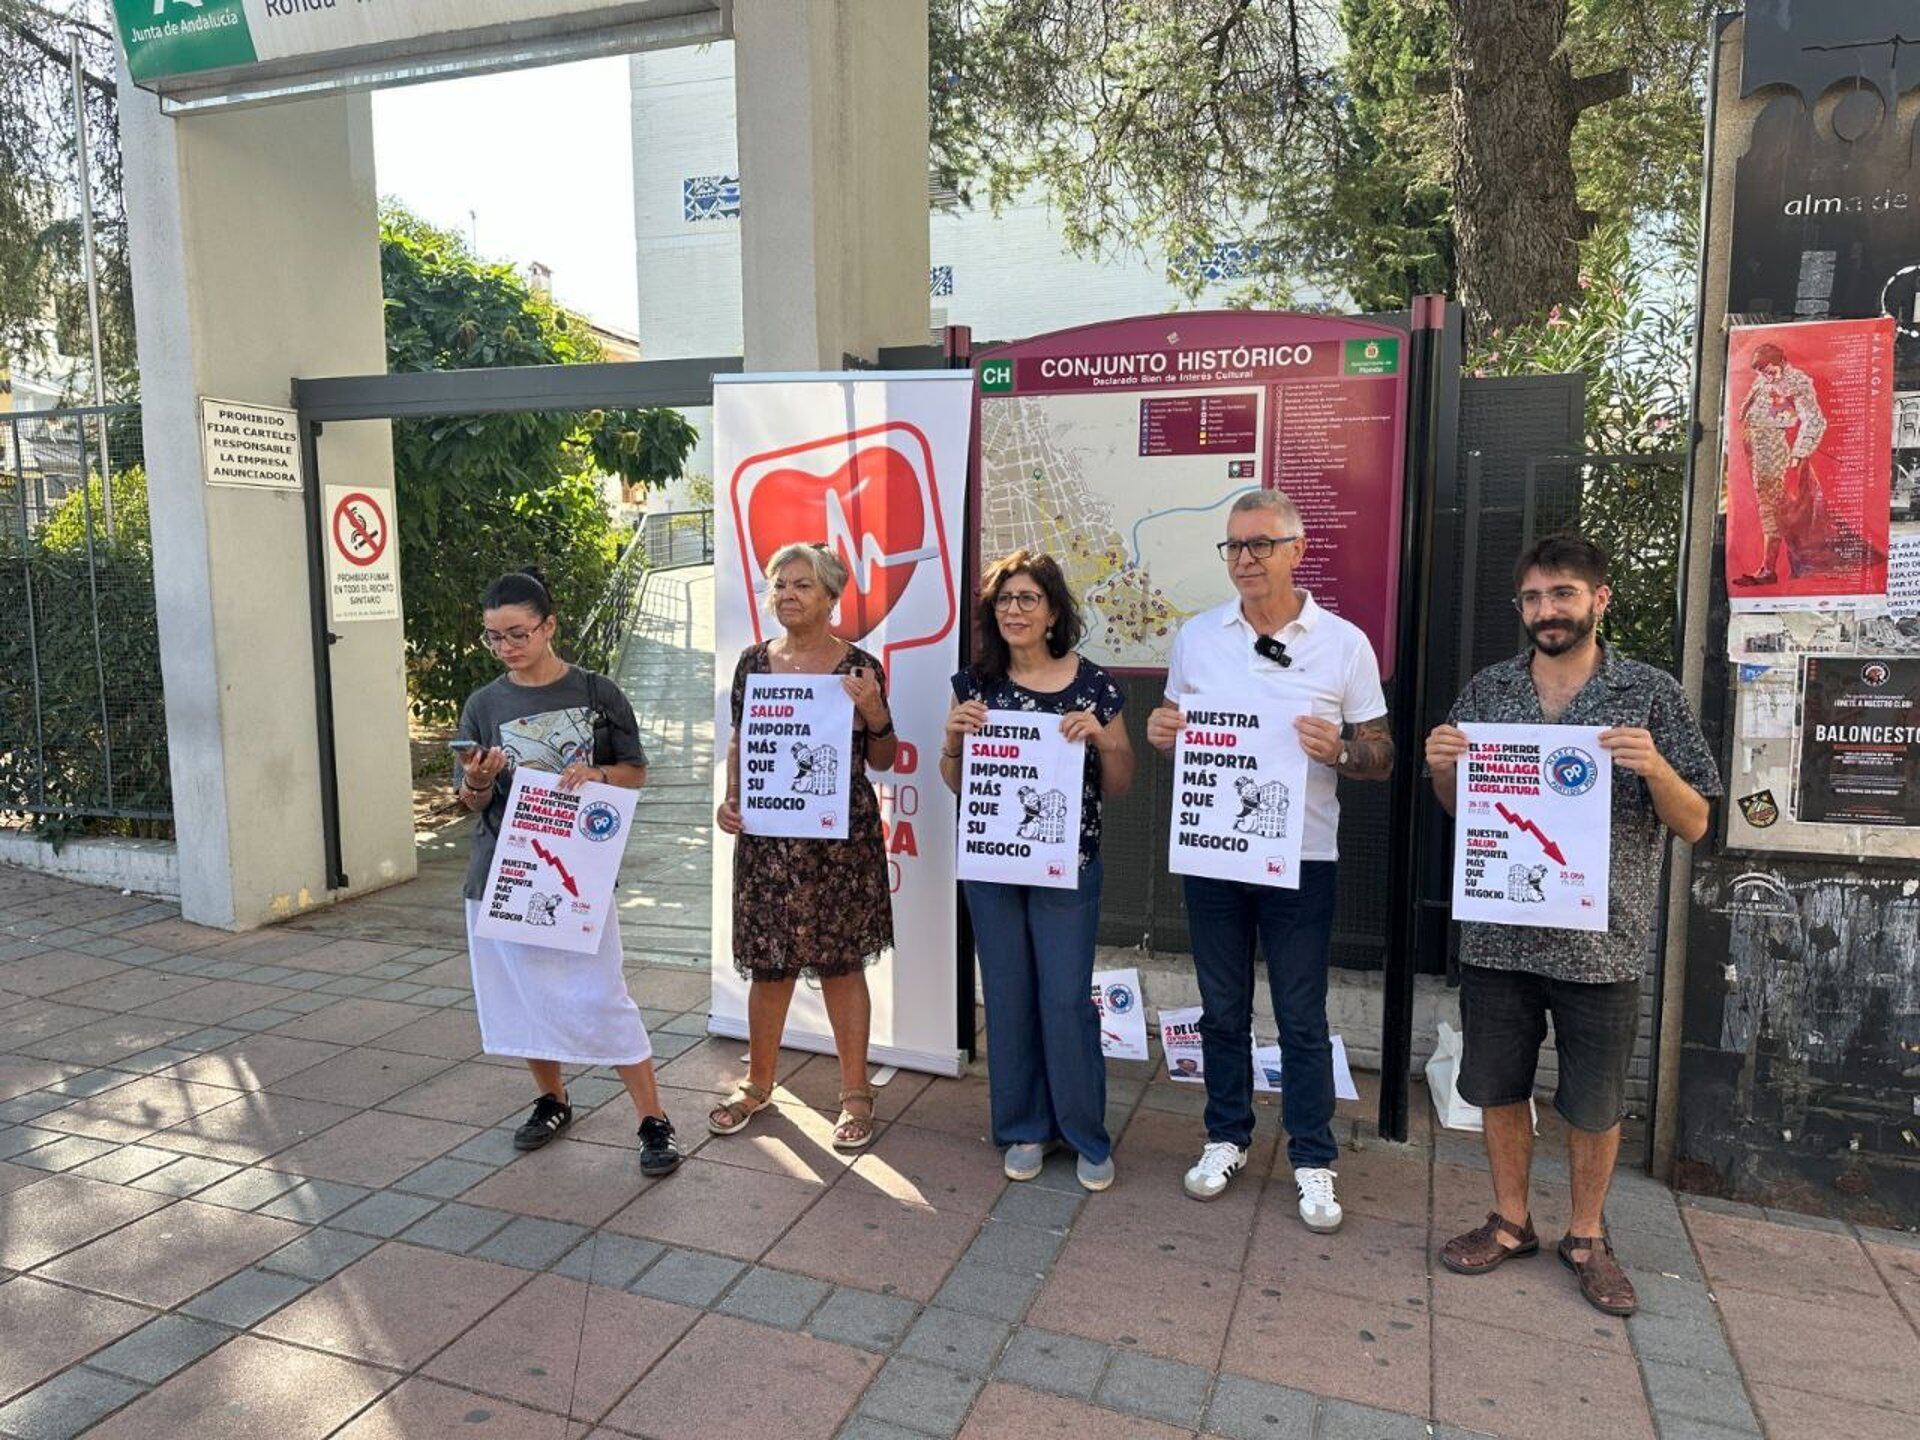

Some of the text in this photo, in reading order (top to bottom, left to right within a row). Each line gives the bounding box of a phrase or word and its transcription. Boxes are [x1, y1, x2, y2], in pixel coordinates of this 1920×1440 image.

[131, 8, 239, 43] Junta de Andalucía
[983, 344, 1312, 385] CH CONJUNTO HISTÓRICO
[1093, 376, 1137, 386] Declarado
[1165, 373, 1177, 382] de
[219, 410, 285, 426] PROHIBIDO
[207, 422, 297, 442] FIJAR CARTELES
[213, 438, 292, 455] RESPONSABLE
[220, 453, 289, 468] LA EMPRESA
[213, 467, 297, 482] ANUNCIADORA
[752, 687, 814, 700] NUESTRA
[750, 705, 795, 718] SALUD
[1186, 709, 1259, 729] NUESTRA
[748, 723, 812, 736] IMPORTA
[747, 739, 777, 754] MÁS
[1184, 730, 1237, 748] SALUD
[971, 743, 1020, 759] SALUD
[1469, 743, 1540, 754] EL SAS PIERDE
[747, 759, 776, 774] QUE
[1183, 751, 1258, 770] IMPORTA
[1493, 754, 1540, 764] EFECTIVOS
[970, 762, 1039, 780] IMPORTA
[1468, 762, 1485, 773] EN
[747, 777, 765, 791] SU
[1183, 769, 1217, 787] MÁS
[1468, 774, 1540, 785] DURANTE ESTA
[969, 780, 1001, 796] MÁS
[1468, 783, 1540, 796] LEGISLATURA
[747, 796, 806, 811] NEGOCIO
[1181, 791, 1214, 807] QUE
[516, 802, 531, 812] EN
[968, 801, 999, 816] QUE
[1179, 811, 1200, 826] SU
[967, 821, 987, 835] SU
[1466, 828, 1509, 839] NUESTRA
[966, 839, 1031, 858] NEGOCIO
[1178, 831, 1249, 852] NEGOCIO
[1466, 838, 1498, 848] SALUD
[1466, 848, 1509, 860] IMPORTA
[1465, 868, 1485, 879] QUE
[1465, 878, 1477, 887] SU
[1464, 888, 1505, 900] NEGOCIO
[1165, 1025, 1173, 1036] 2
[1173, 1024, 1187, 1035] DE
